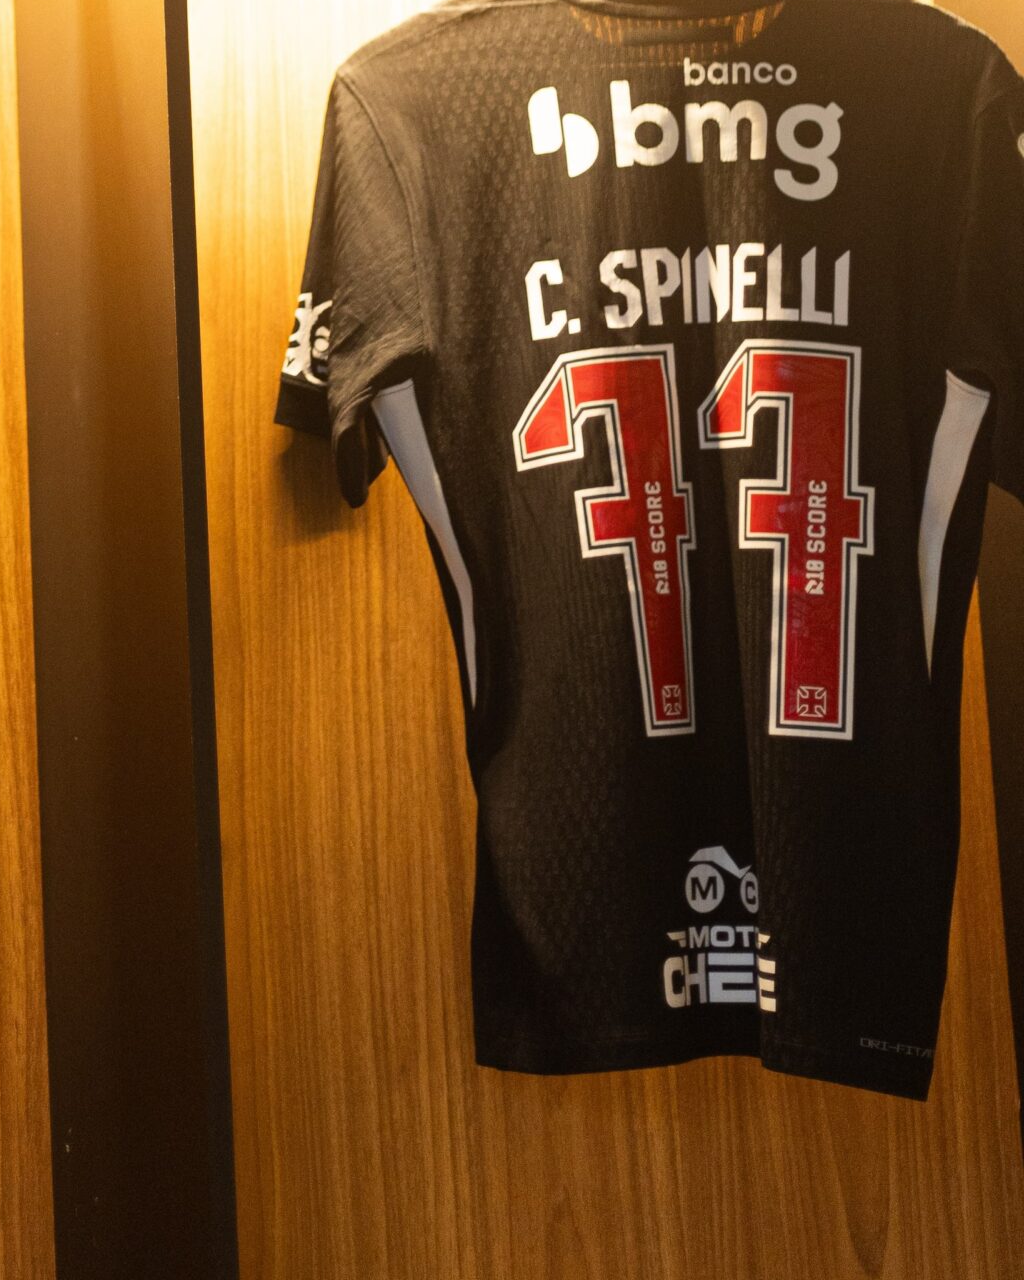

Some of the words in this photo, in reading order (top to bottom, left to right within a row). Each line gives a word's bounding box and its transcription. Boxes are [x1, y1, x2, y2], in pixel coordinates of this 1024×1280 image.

[683, 57, 797, 86] banco
[610, 80, 844, 201] bmg
[525, 259, 581, 341] C.
[599, 242, 851, 330] SPINELLI
[512, 338, 875, 741] 77
[644, 481, 666, 554] SCORE
[807, 479, 827, 554] SCORE
[688, 925, 759, 949] MOT
